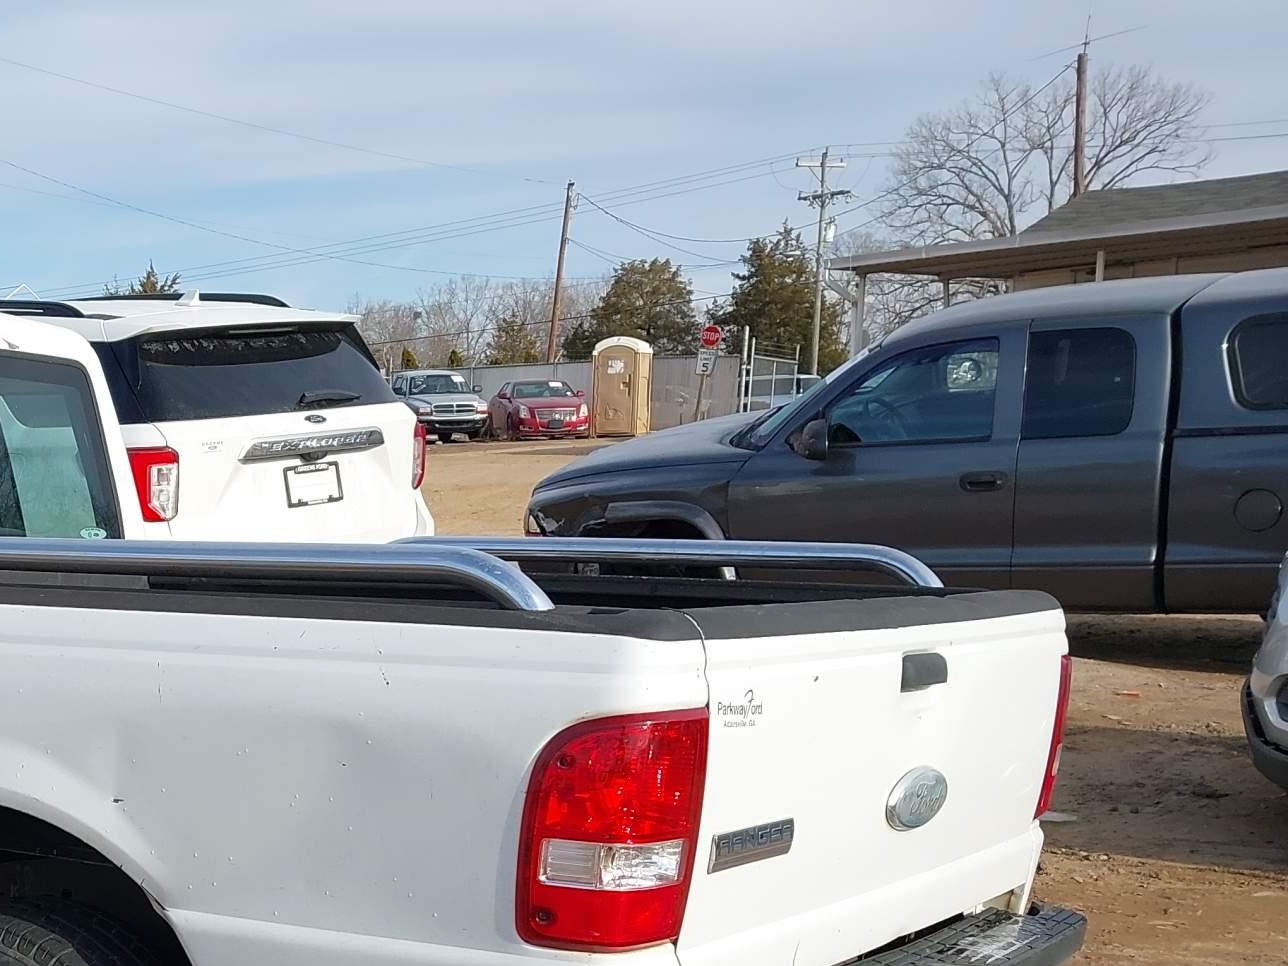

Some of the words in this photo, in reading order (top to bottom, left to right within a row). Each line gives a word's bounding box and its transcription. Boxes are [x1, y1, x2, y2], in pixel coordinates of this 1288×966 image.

[702, 331, 720, 341] STOP
[701, 362, 710, 372] 5
[717, 821, 794, 857] RANGER
